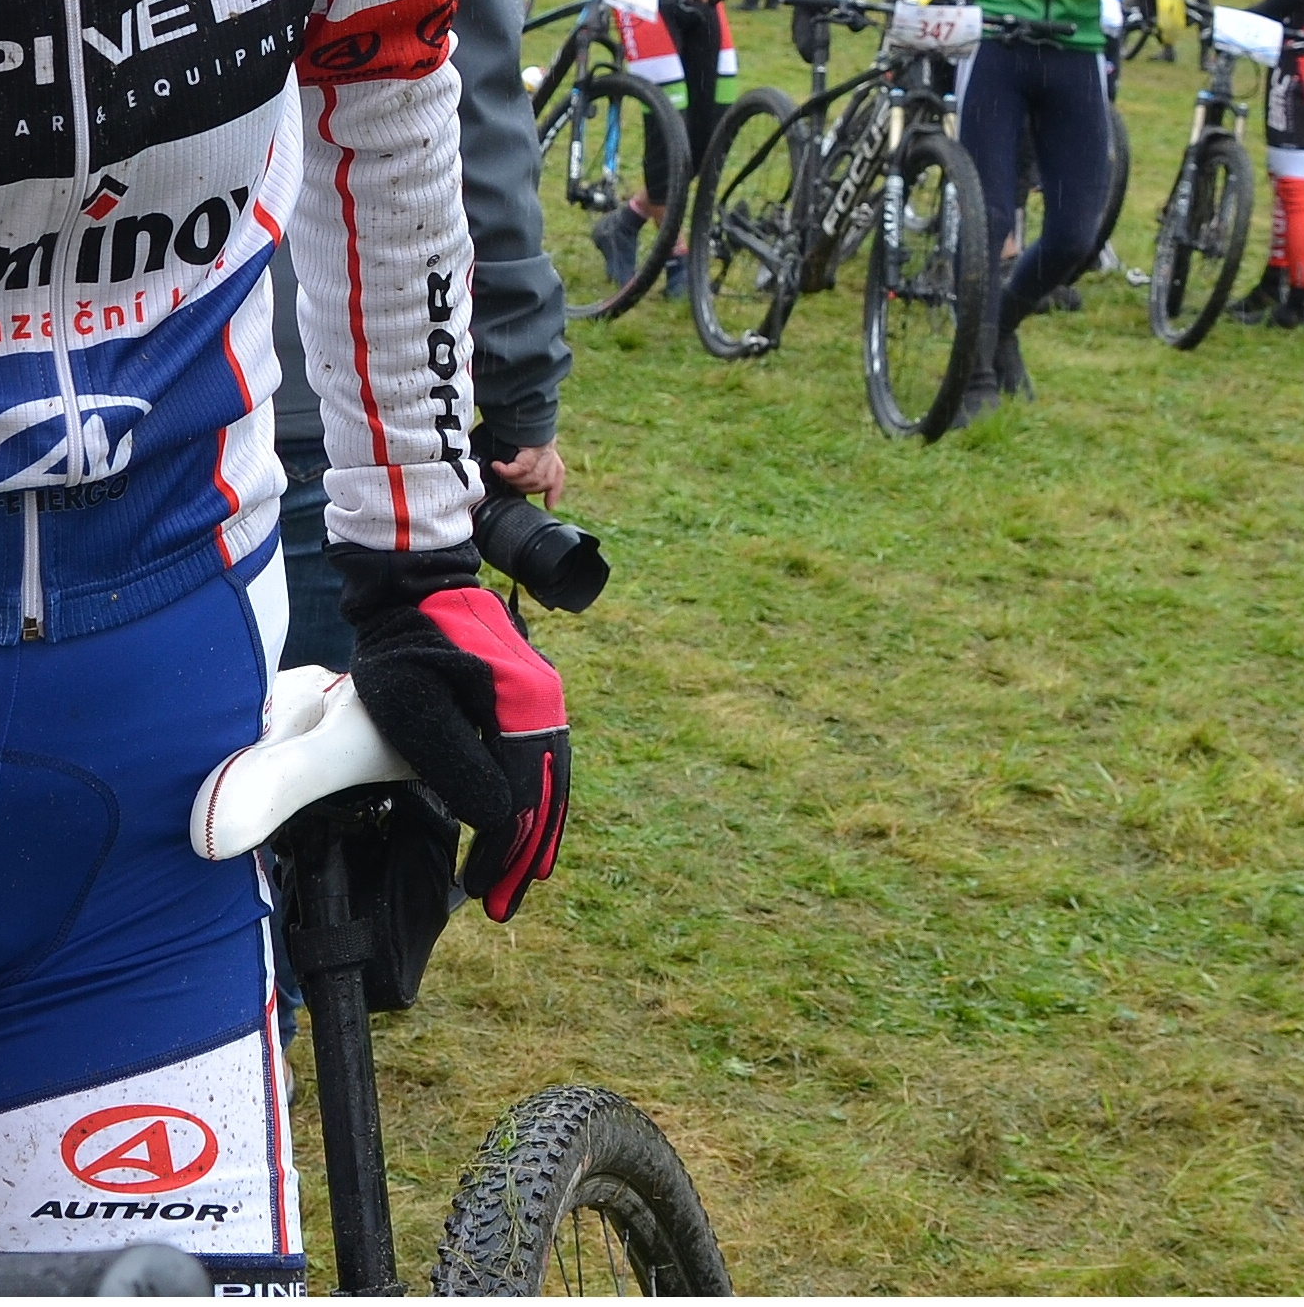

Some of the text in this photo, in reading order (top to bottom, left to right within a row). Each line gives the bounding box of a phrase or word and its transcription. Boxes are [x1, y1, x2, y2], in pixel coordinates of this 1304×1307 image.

[918, 21, 956, 40] 347
[126, 12, 309, 110] EQUIPME
[30, 1200, 229, 1223] AUTHOR
